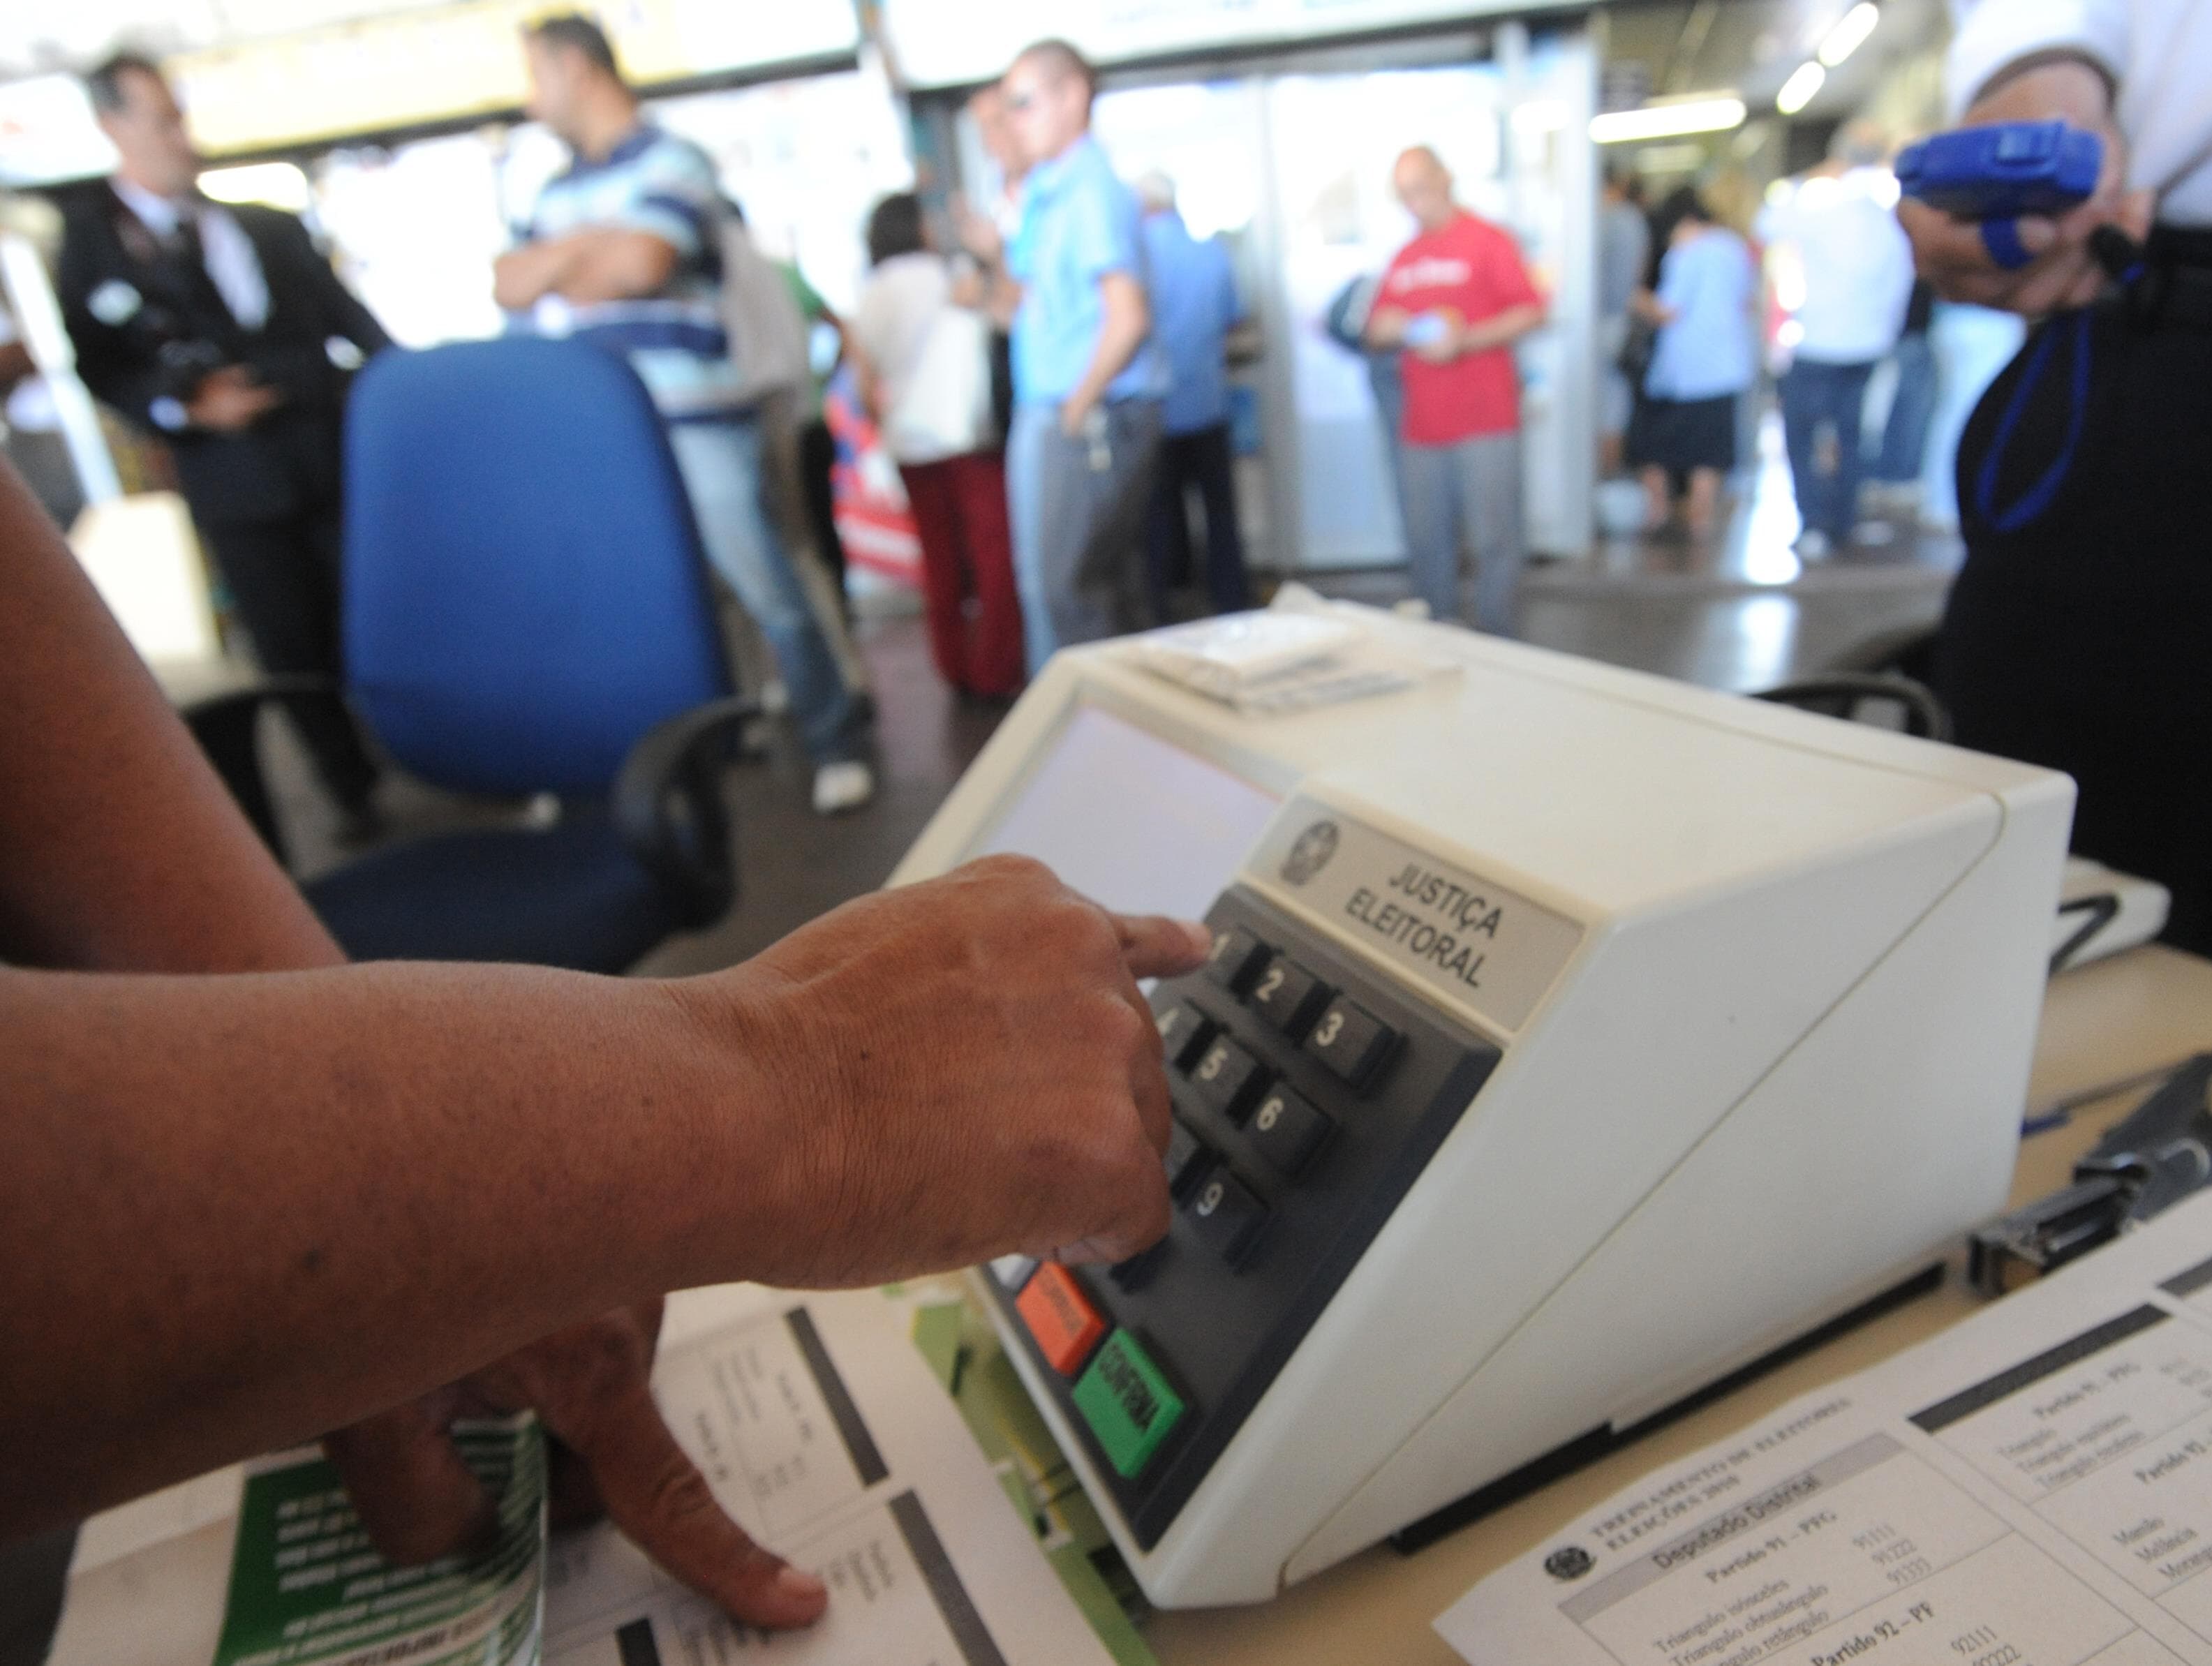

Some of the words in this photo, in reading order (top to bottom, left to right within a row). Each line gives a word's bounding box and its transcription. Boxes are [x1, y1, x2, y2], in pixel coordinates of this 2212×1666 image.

[1345, 887, 1485, 988] ELEITORAL
[1389, 863, 1502, 939] JUSTIÇA
[1256, 967, 1285, 1002] 2
[1316, 1011, 1344, 1046] 3
[1201, 1048, 1229, 1080] 5
[1257, 1097, 1284, 1131] 6
[1196, 1182, 1224, 1217] 9
[1651, 1513, 1749, 1570] Deputado
[1745, 1471, 1821, 1522] Distrital
[1705, 1547, 1767, 1584] Partido
[1810, 1635, 1878, 1666] Partido
[1873, 1620, 1901, 1642] 92
